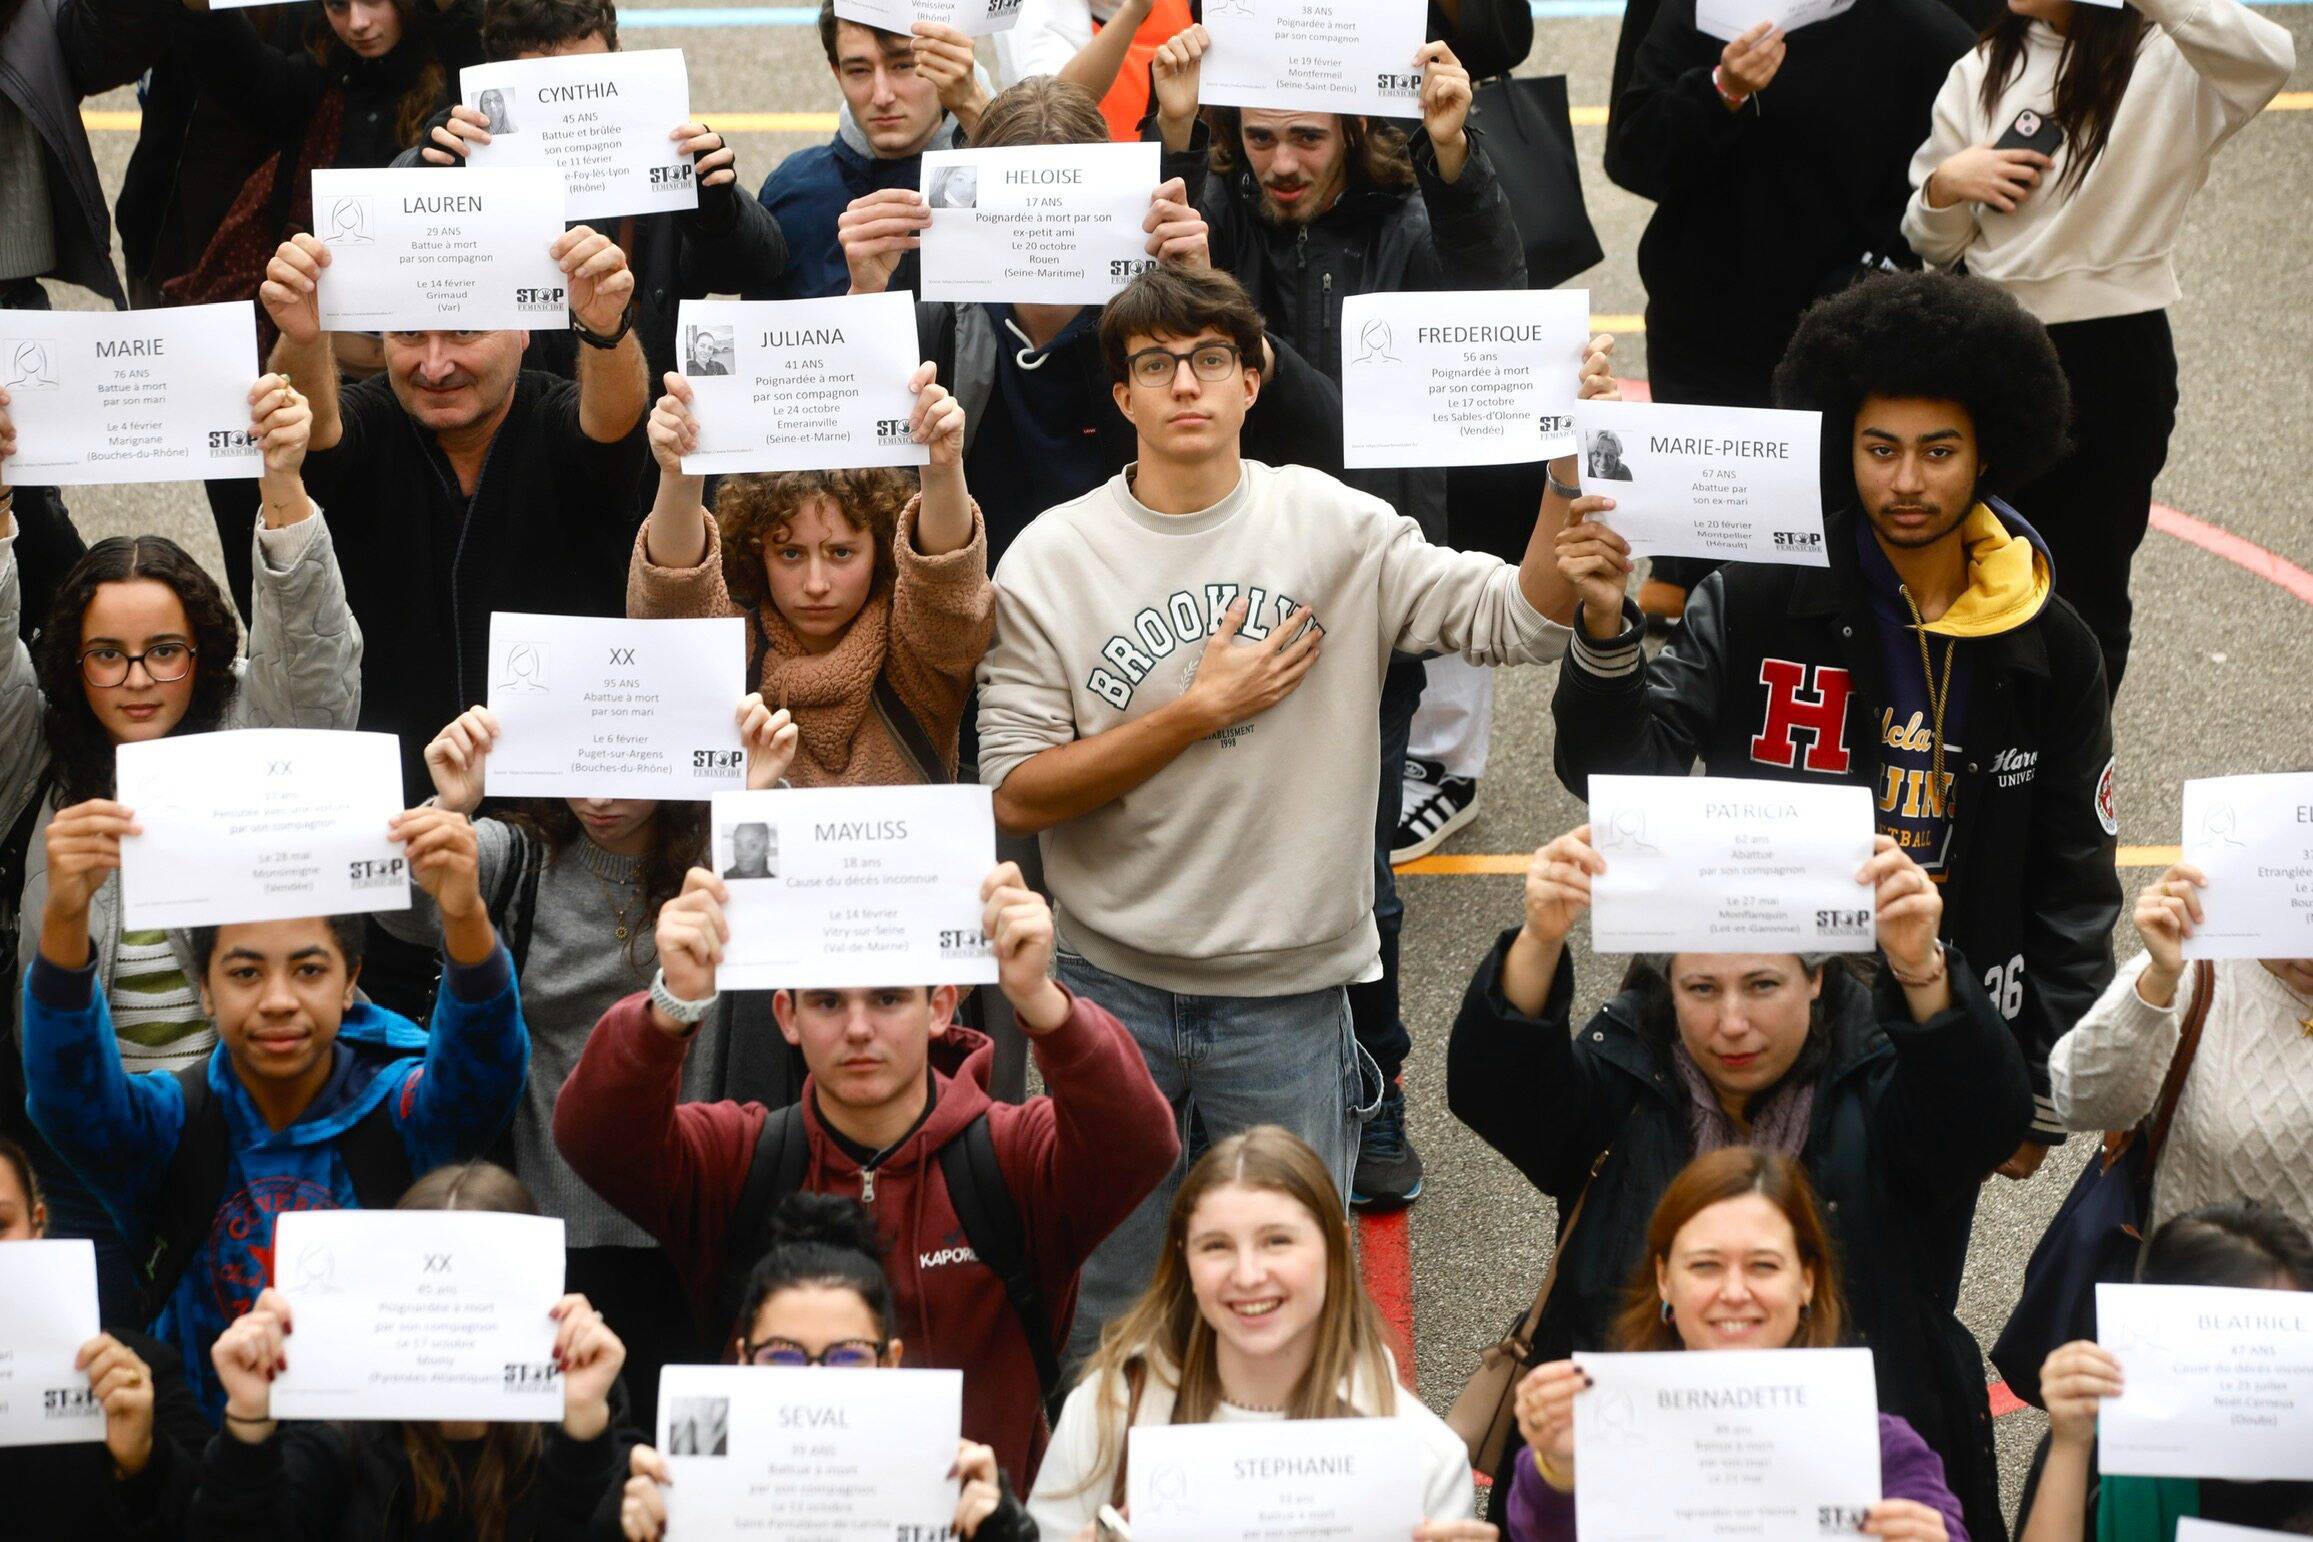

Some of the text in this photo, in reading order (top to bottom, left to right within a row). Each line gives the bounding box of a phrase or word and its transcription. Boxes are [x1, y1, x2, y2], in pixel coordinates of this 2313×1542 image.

[1302, 6, 1332, 16] 38 ANS
[916, 12, 950, 24] (Rhône)
[1277, 17, 1356, 31] Poignardée mort
[1275, 32, 1359, 44] par son compagnon
[1302, 57, 1312, 65] 19
[1314, 57, 1342, 68] février
[1288, 69, 1342, 79] Montfermeil
[1378, 74, 1421, 90] STOP
[538, 82, 618, 104] CYNTHIA
[563, 112, 598, 123] 45 ANS
[542, 130, 574, 140] Battue
[577, 129, 586, 138] et
[544, 138, 622, 154] son compagnon
[557, 153, 612, 167] Le 11 février
[650, 164, 692, 184] STOP
[1006, 168, 1082, 184] HELOISE
[570, 181, 606, 195] (Rhône)
[404, 196, 482, 214] LAUREN
[1026, 198, 1062, 206] 17 ANS
[976, 212, 1112, 224] Poignardée mort par son
[426, 227, 460, 236] 29 ANS
[1013, 228, 1074, 238] ex-petit ami
[411, 240, 476, 249] Battue mort
[1012, 242, 1076, 251] Le 20 octobre
[400, 256, 414, 265] par
[437, 254, 493, 264] compagnon
[1030, 255, 1059, 264] Rouen
[1005, 268, 1084, 279] (Seine-Maritime)
[417, 279, 475, 288] Le 14 février
[426, 290, 468, 300] Grimaud
[517, 288, 564, 303] STOP
[438, 302, 460, 312] (Var)
[761, 328, 845, 348] JULIANA
[1418, 325, 1542, 344] FREDERIQUE
[97, 338, 164, 358] MARIE
[1464, 352, 1476, 362] 56
[784, 360, 824, 369] 41 ANS
[114, 369, 150, 380] 76 ANS
[1432, 366, 1529, 378] Poignardée mort
[756, 374, 855, 387] Poignardée mort
[98, 382, 167, 392] Battue mort
[1429, 382, 1533, 395] par son compagnon
[104, 398, 120, 407] par
[143, 395, 166, 404] mari
[753, 388, 858, 403] par son compagnon
[1448, 397, 1514, 408] Le 17 octobre
[773, 404, 840, 416] Le 24 octobre
[778, 418, 838, 430] Emerainville
[1433, 414, 1448, 422] Les
[1540, 414, 1575, 432] STO
[107, 420, 162, 431] Le 4 février
[877, 419, 913, 436] STO
[1460, 424, 1504, 436] (Vendée)
[109, 436, 162, 446] Marignane
[766, 431, 850, 446] (Seine-et-Marne)
[1651, 436, 1788, 458] MARIE-PIERRE
[87, 446, 189, 463] (Bouches-du-Rhône)
[1703, 469, 1736, 480] 67 ANS
[1692, 483, 1747, 494] Abattue par
[1714, 498, 1748, 506] ex-mari
[1694, 520, 1752, 529] Le 20 février
[1698, 530, 1752, 541] Montpellier
[1773, 531, 1821, 545] STOP
[610, 648, 634, 666] XX
[604, 679, 640, 688] 95 ANS
[584, 693, 659, 702] Abattue mort
[592, 708, 654, 717] par son mari
[1750, 658, 1855, 774] H
[594, 735, 604, 743] Le
[607, 734, 613, 743] 6
[1220, 738, 1236, 748] 1998
[579, 748, 663, 760] Puget-sur-Argens
[693, 750, 742, 768] STOP
[571, 762, 672, 775] (Bouches-du-Rhône)
[694, 768, 741, 777] FEMINICIDE
[1706, 804, 1799, 819] PATRICIA
[815, 820, 908, 842] MAYLISS
[350, 858, 403, 879] STOP
[844, 857, 881, 868] 18 ans
[786, 874, 938, 888] Cause du inconnue
[830, 910, 841, 920] Le
[1816, 910, 1869, 928] STOP
[424, 1254, 452, 1272] XX
[2198, 1314, 2306, 1332] BEATRICE
[1657, 1386, 1806, 1410] BERNADETTE
[779, 1405, 849, 1429] SEVAL
[1234, 1455, 1354, 1480] STEPHANIE
